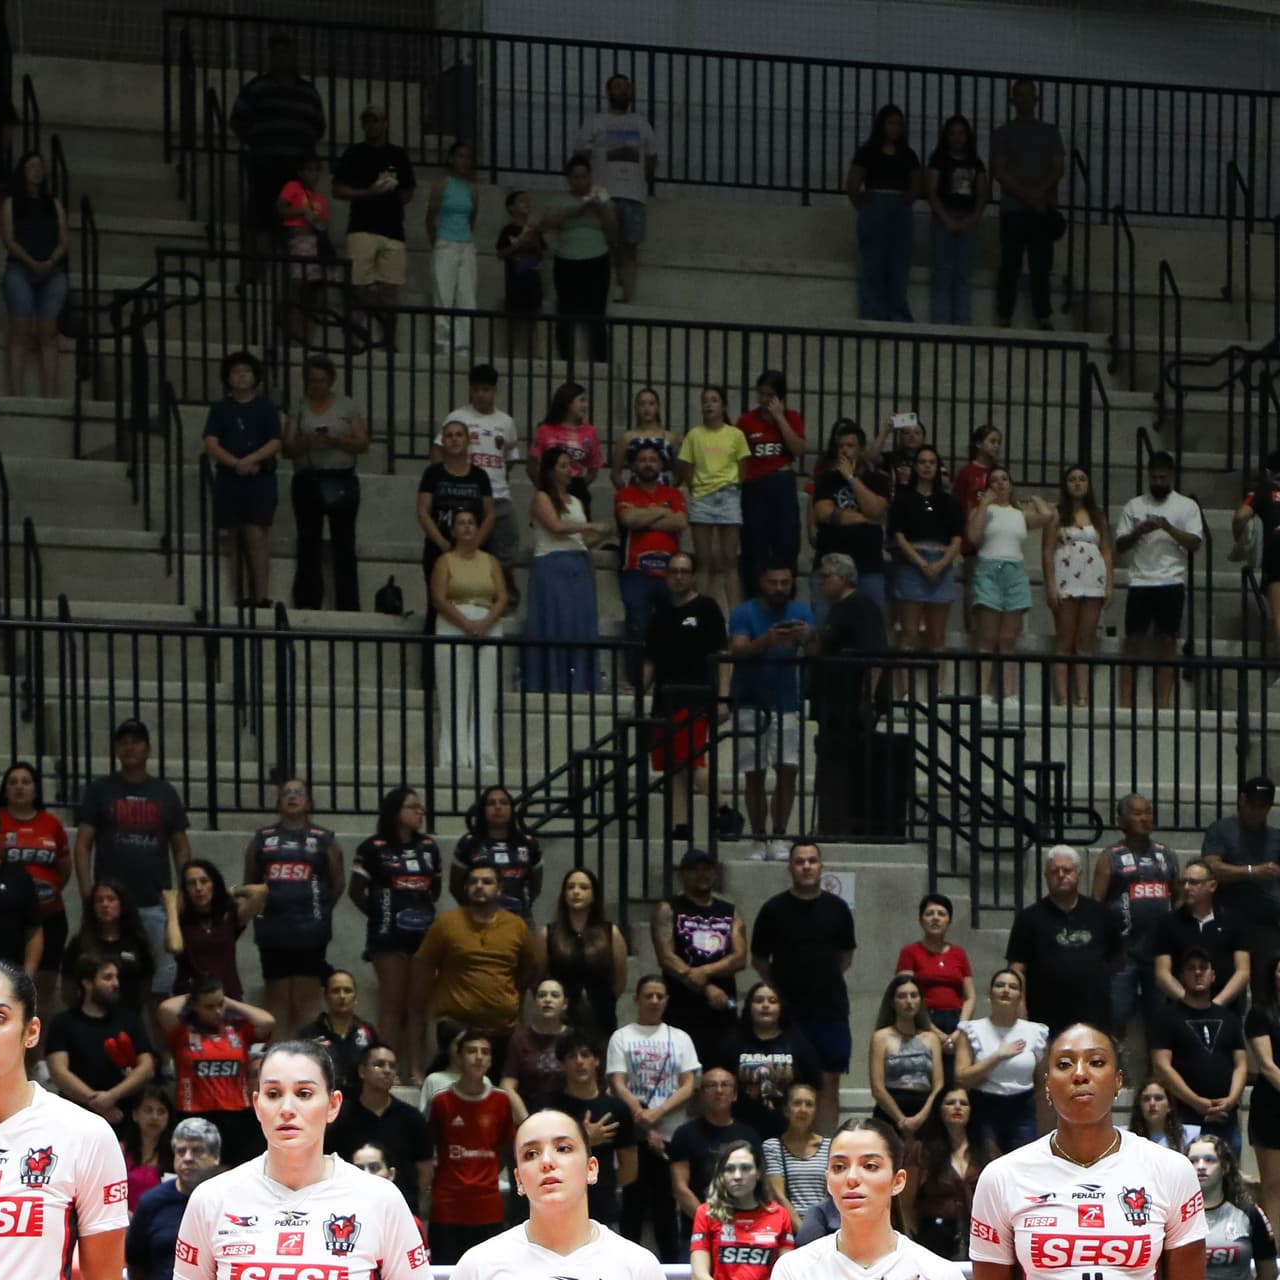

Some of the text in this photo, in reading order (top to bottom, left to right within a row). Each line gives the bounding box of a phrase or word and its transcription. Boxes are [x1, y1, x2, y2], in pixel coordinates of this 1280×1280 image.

[754, 442, 784, 457] SES
[7, 848, 56, 864] SESI
[269, 864, 310, 880] SESI
[1134, 883, 1166, 899] SESI
[196, 1061, 239, 1077] SESI
[1026, 1218, 1054, 1226] FIESP
[327, 1242, 353, 1251] SESI
[1041, 1239, 1141, 1266] SESI
[722, 1249, 770, 1265] SESI
